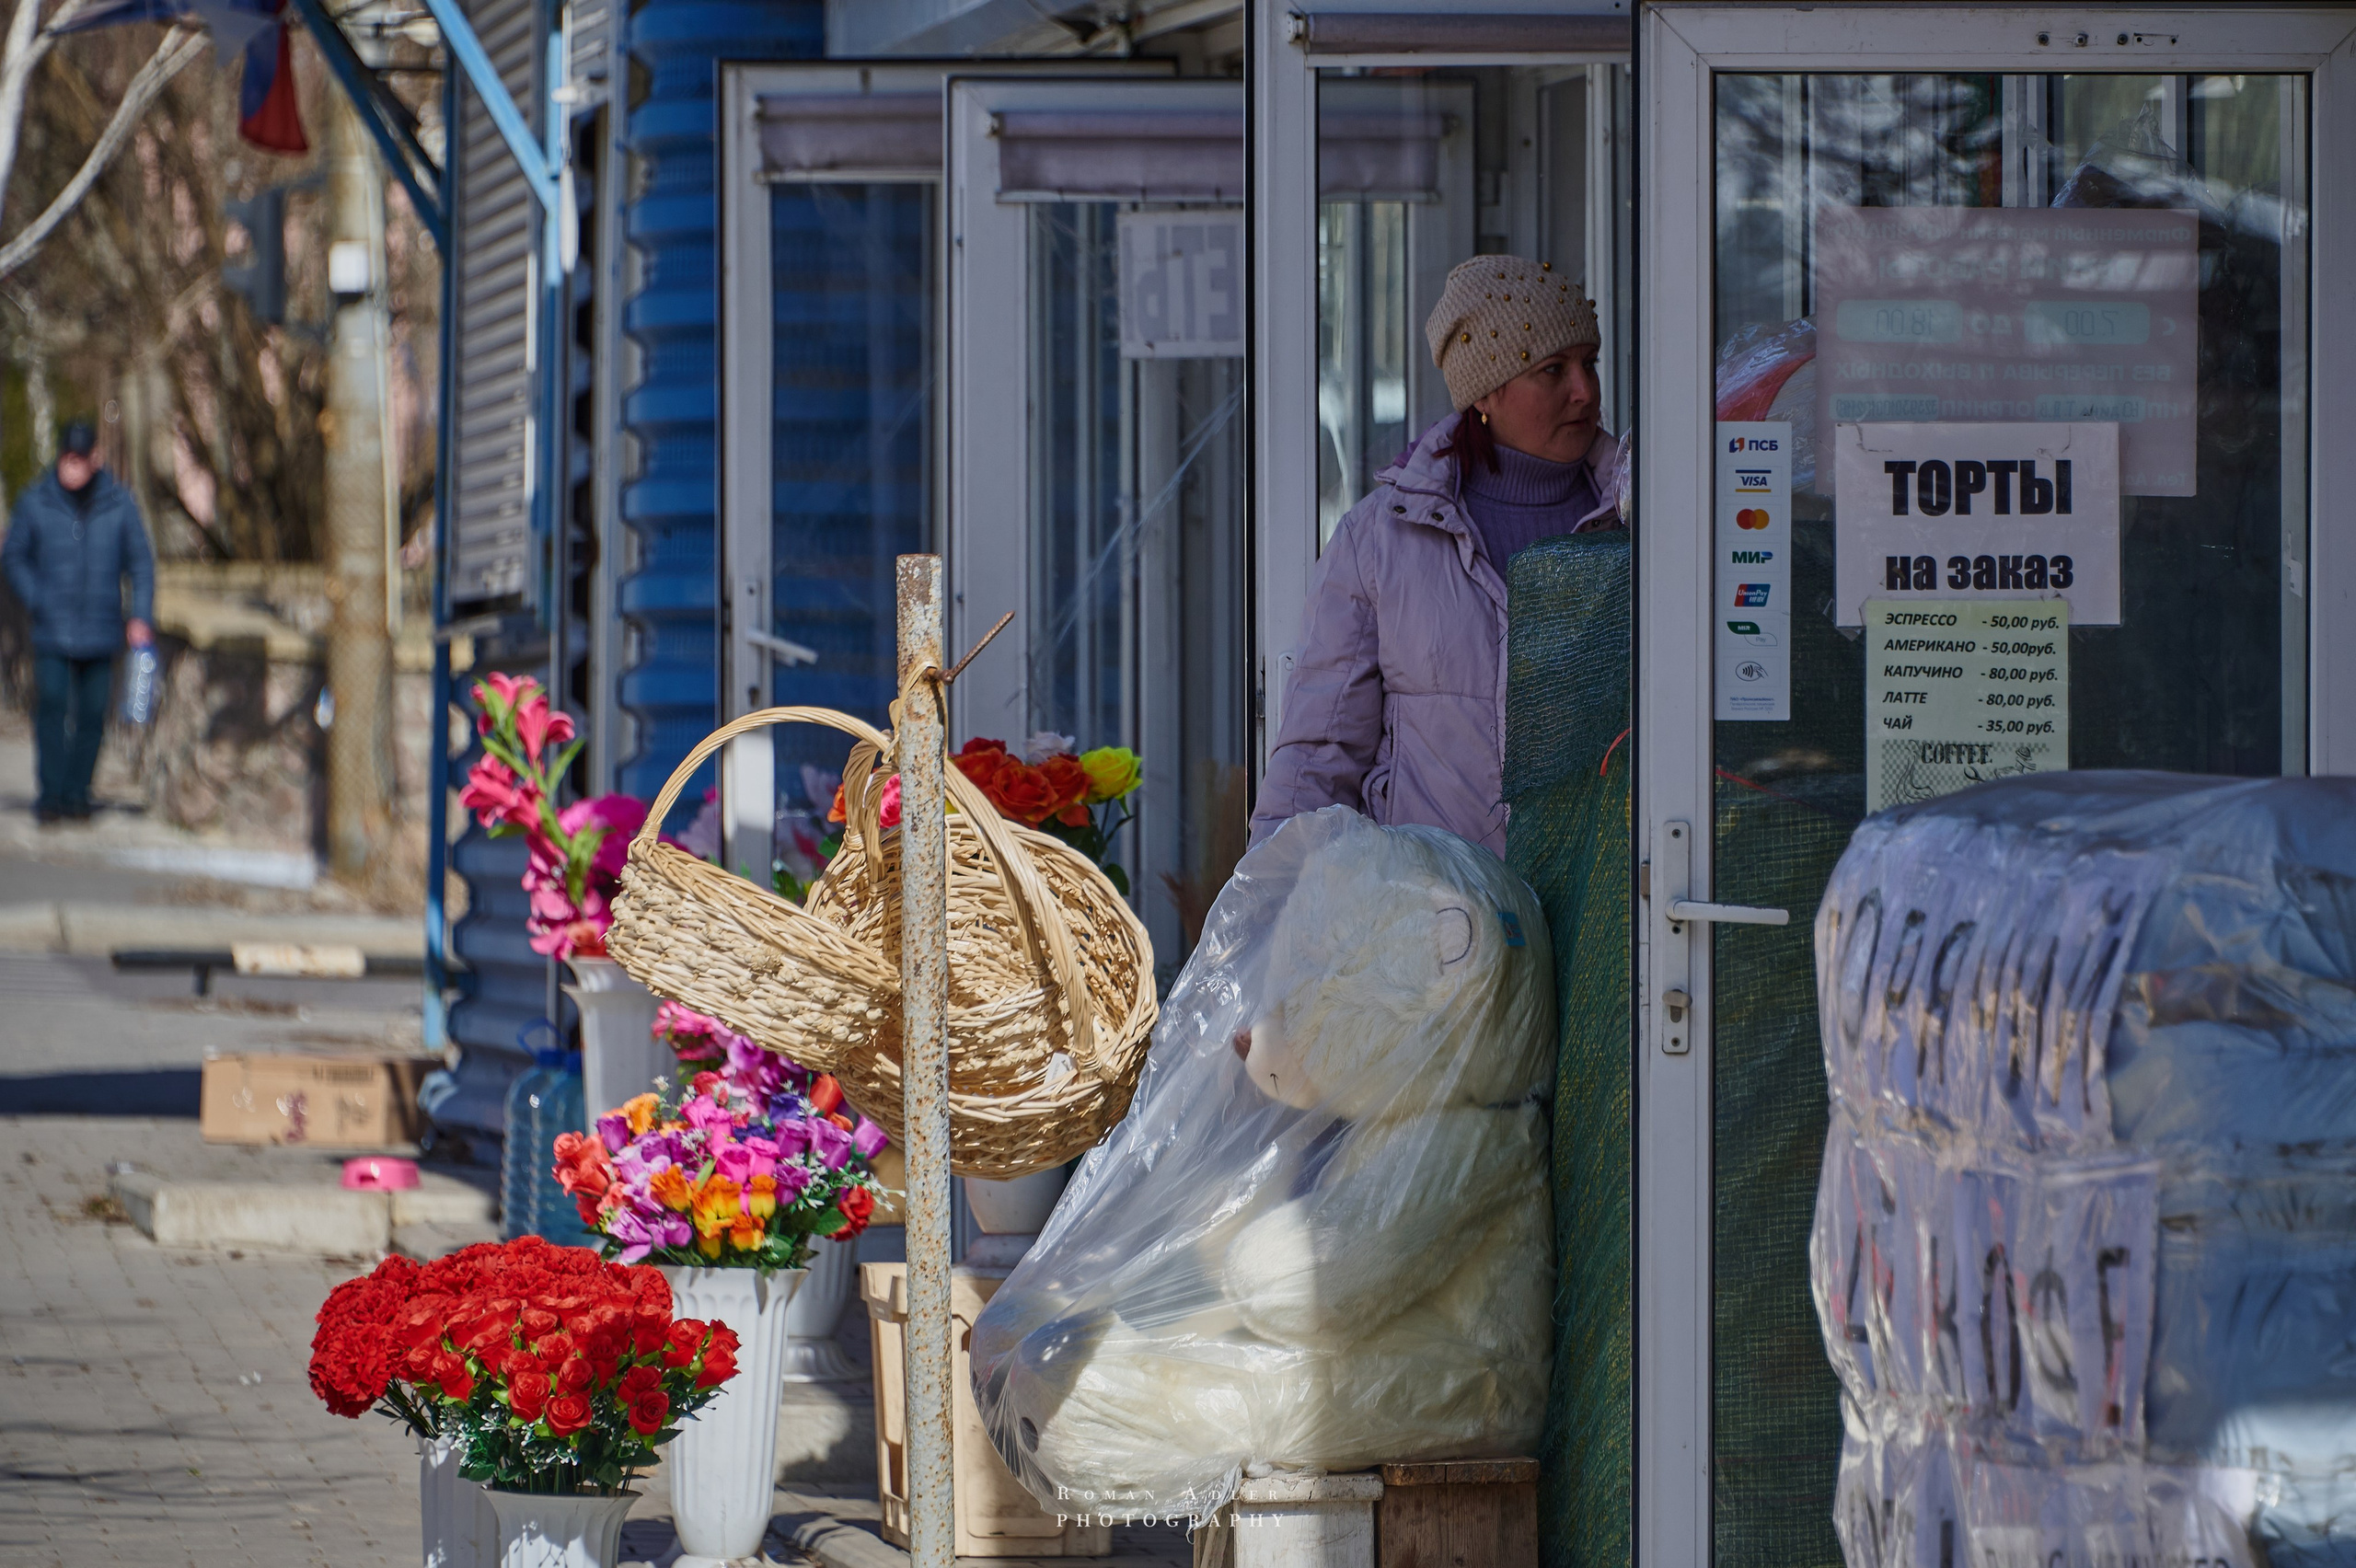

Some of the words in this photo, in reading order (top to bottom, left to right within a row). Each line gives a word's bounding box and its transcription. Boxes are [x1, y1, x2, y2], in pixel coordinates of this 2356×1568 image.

[1749, 440, 1778, 451] ПСБ
[1739, 476, 1768, 487] VISA
[1885, 459, 2073, 516] ТОРТЫ
[1732, 551, 1773, 564] МИР
[1886, 556, 1937, 591] на
[1946, 555, 2073, 591] заказ
[1884, 612, 1958, 627] ЭСПРЕССО
[1990, 615, 2028, 629] 50,00
[2030, 617, 2060, 631] руб.
[1883, 639, 1976, 652] АМЕРИКАНО
[1883, 664, 1963, 679] КАПУЧИНО
[1989, 667, 2027, 682] 80,00
[2029, 668, 2059, 683] руб.
[1882, 691, 1928, 704] ЛАТТЕ
[1986, 694, 2025, 708] 80,00
[2027, 695, 2056, 709] руб.
[1882, 715, 1913, 731] ЧАЙ
[1985, 720, 2024, 734] 35,00
[2027, 721, 2055, 735] руб.
[1921, 743, 1993, 765] COFFEE
